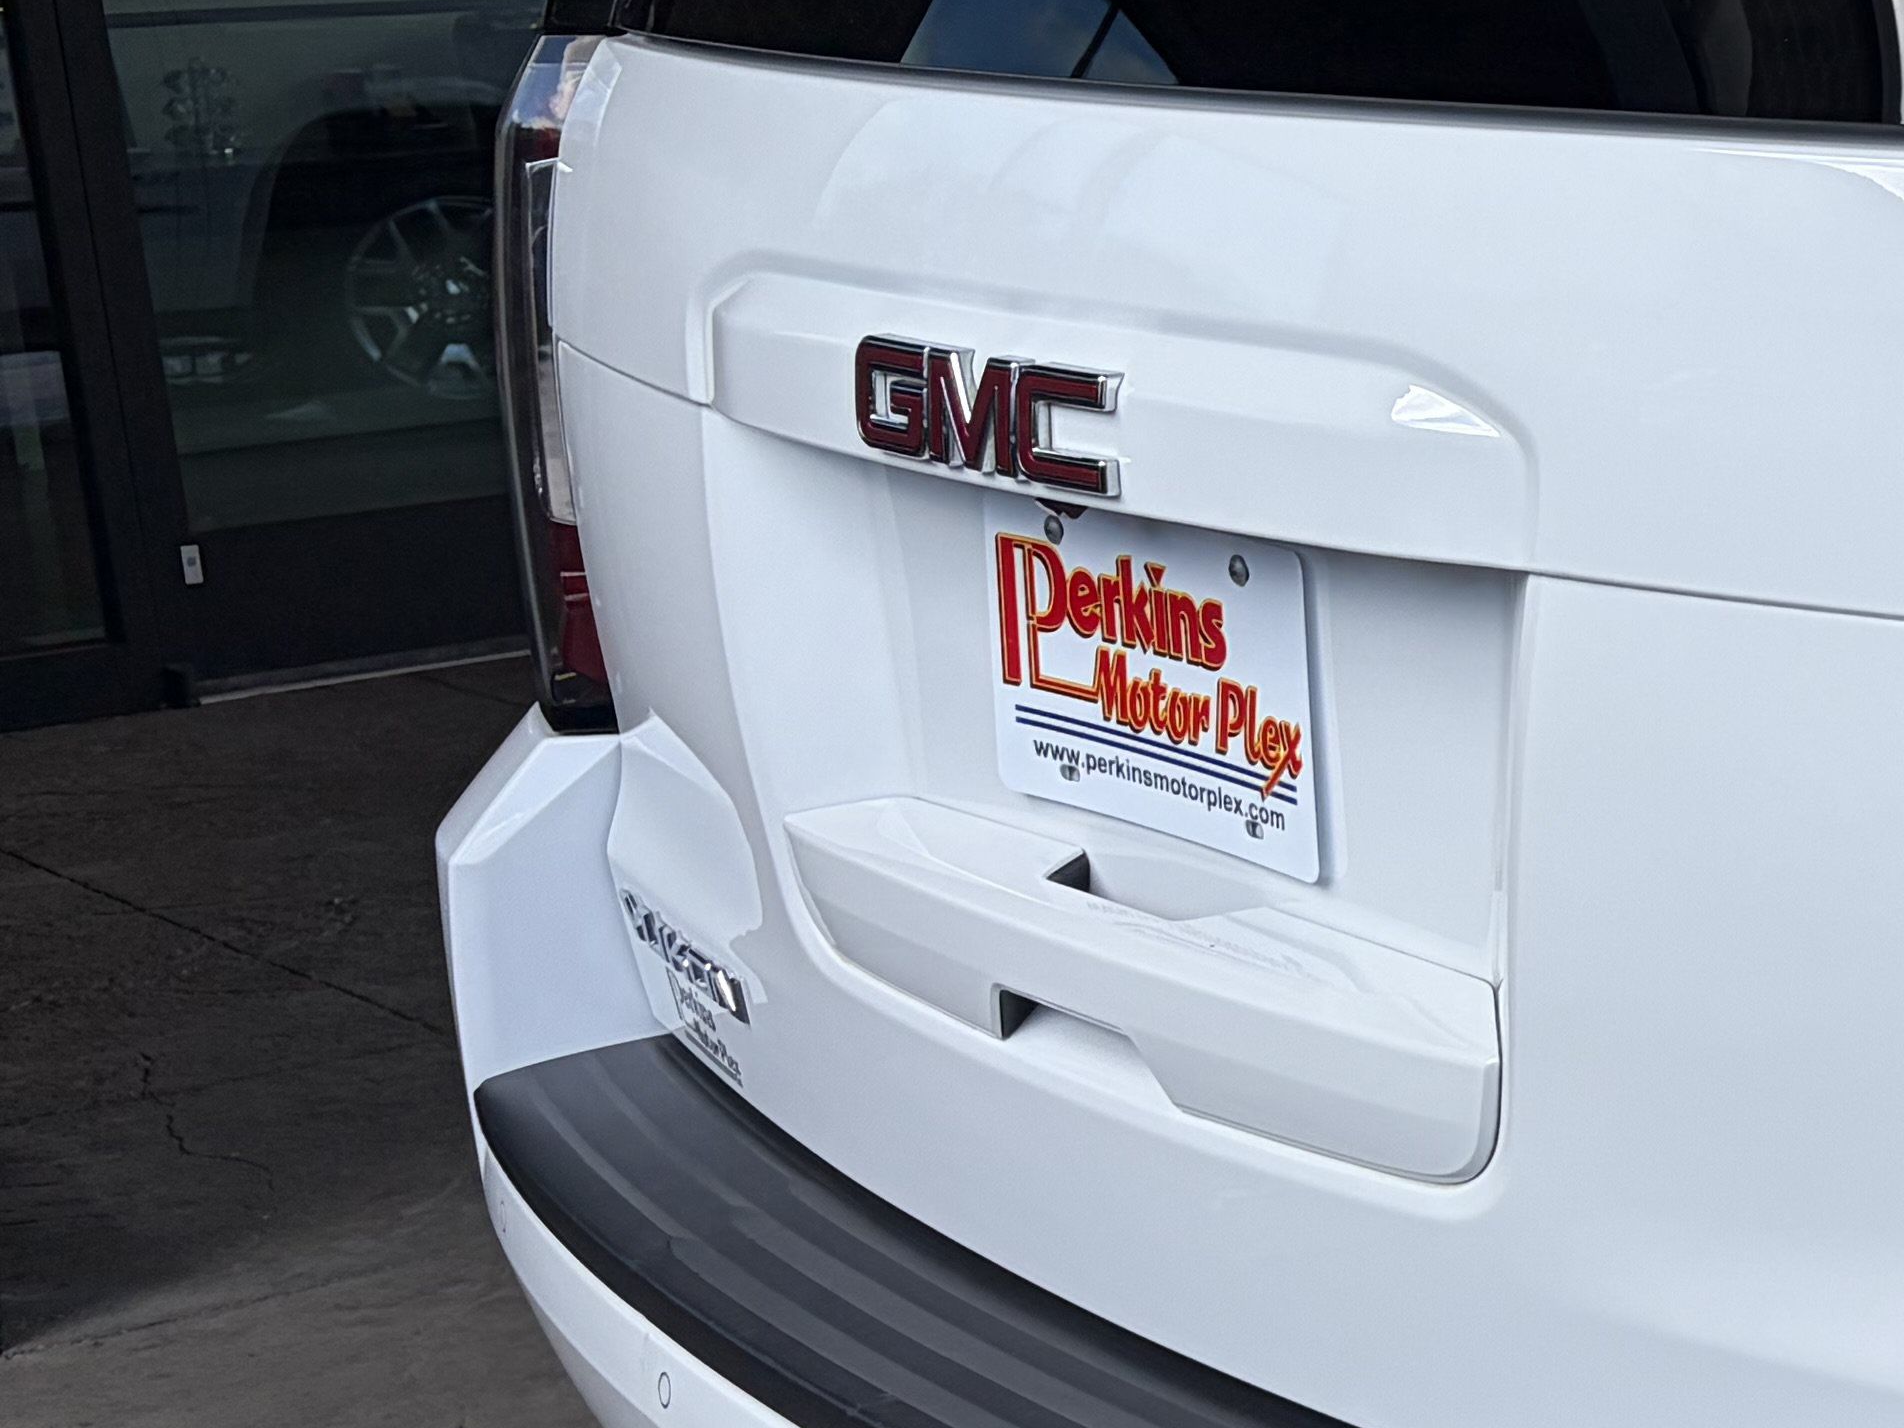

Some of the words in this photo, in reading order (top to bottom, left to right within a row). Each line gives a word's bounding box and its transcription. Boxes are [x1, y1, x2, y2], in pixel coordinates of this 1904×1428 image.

[855, 333, 1125, 497] GMC
[995, 531, 1228, 686] Perkins
[1032, 739, 1286, 831] www.perkinsmotorplex.com
[1096, 646, 1211, 745] Motor
[1215, 676, 1304, 801] Plex
